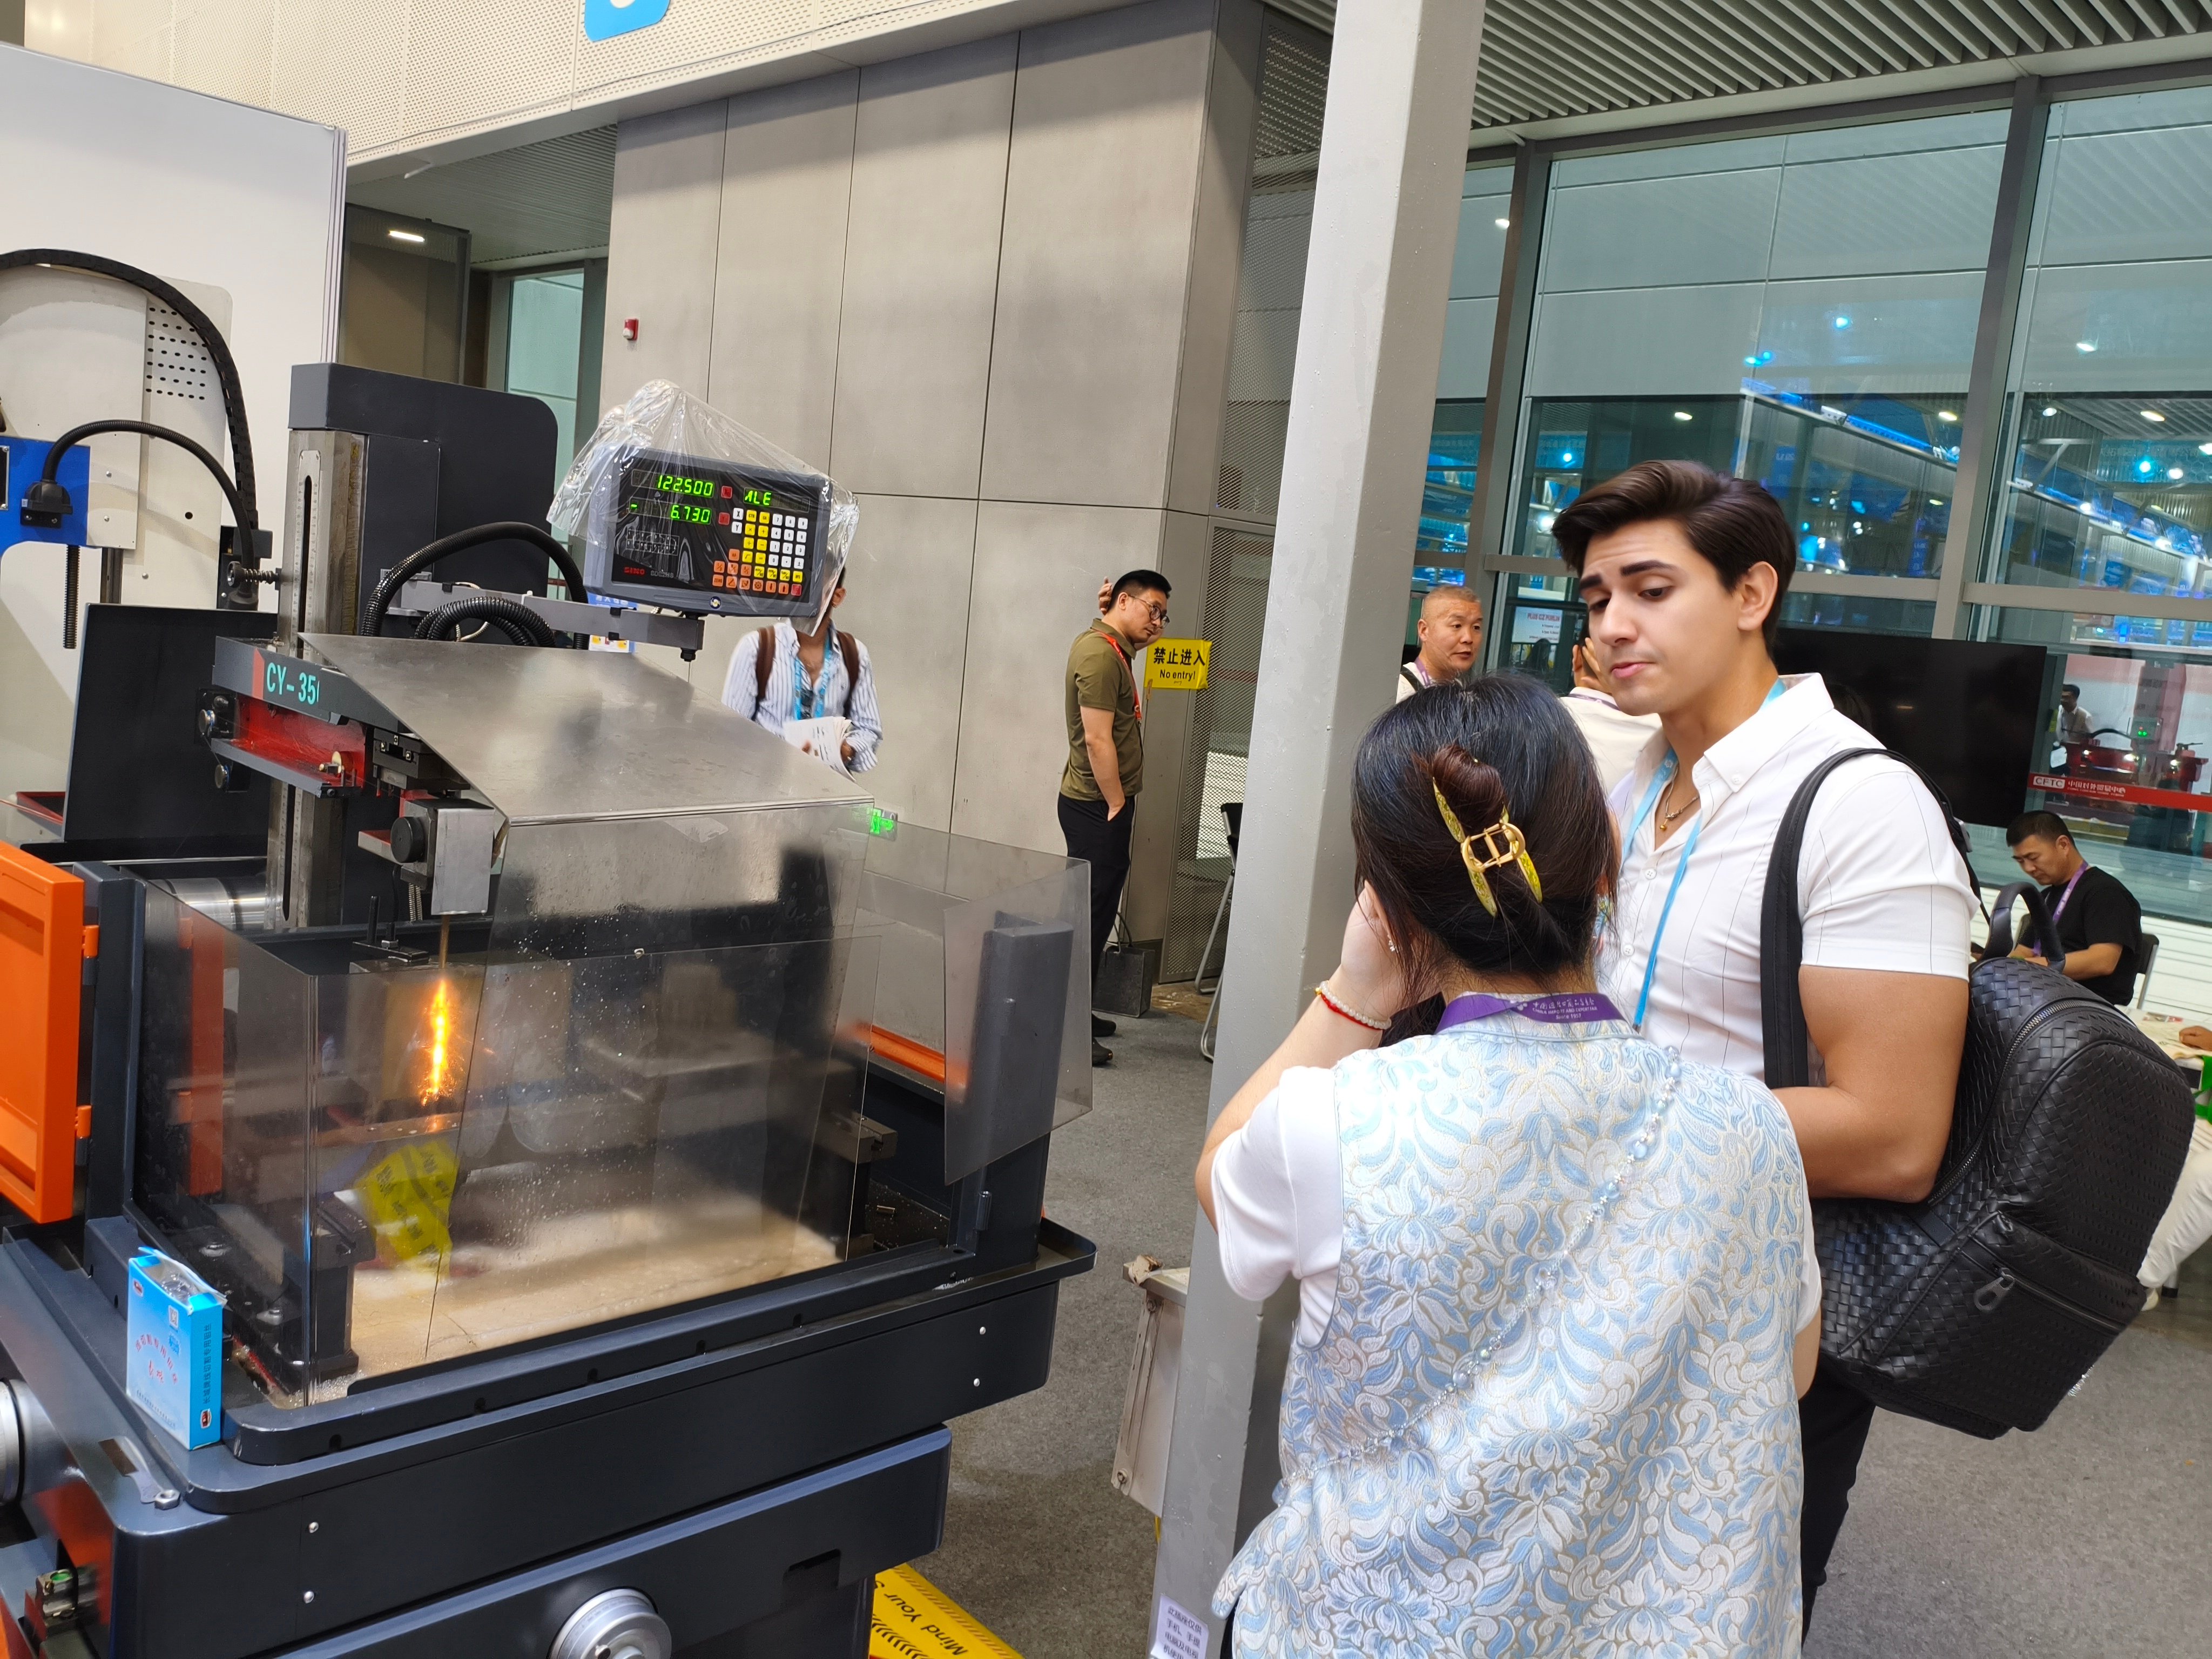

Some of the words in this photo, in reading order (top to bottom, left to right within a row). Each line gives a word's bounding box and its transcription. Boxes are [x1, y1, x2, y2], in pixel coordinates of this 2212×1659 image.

[657, 475, 713, 496] 122.500
[745, 490, 772, 505] ALE
[671, 504, 711, 523] 6.730
[1154, 646, 1205, 666] 禁止进入
[266, 662, 320, 704] CY-35
[1159, 669, 1171, 678] No
[1172, 670, 1195, 682] entry!
[2035, 777, 2063, 787] CFTC
[884, 1593, 922, 1622] Your
[921, 1624, 969, 1656] Mind
